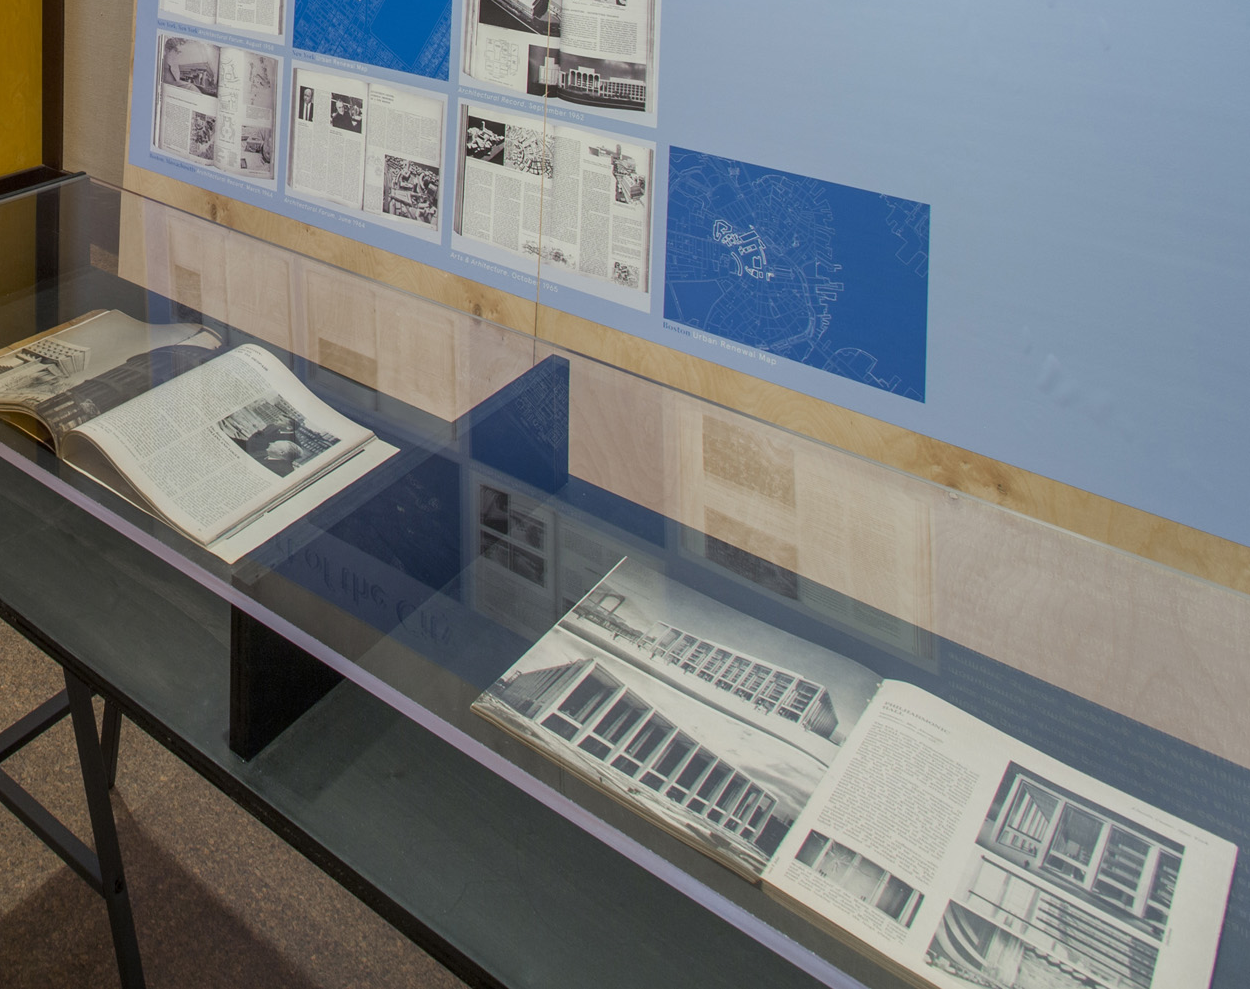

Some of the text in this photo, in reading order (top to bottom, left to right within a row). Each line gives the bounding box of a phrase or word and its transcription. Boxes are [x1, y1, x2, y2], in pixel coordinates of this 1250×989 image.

[292, 50, 368, 72] New York Urban Renewal Map
[458, 87, 584, 121] Architectural Record, Septmber 1962
[284, 197, 317, 213] Architectural
[338, 214, 351, 225] June
[353, 218, 365, 228] 1964
[450, 252, 463, 261] Arts
[512, 272, 538, 286] Octobe
[542, 282, 558, 293] 1965
[663, 322, 777, 366] Boston Urban Renewal Map
[884, 701, 951, 735] PHILHARMONIC
